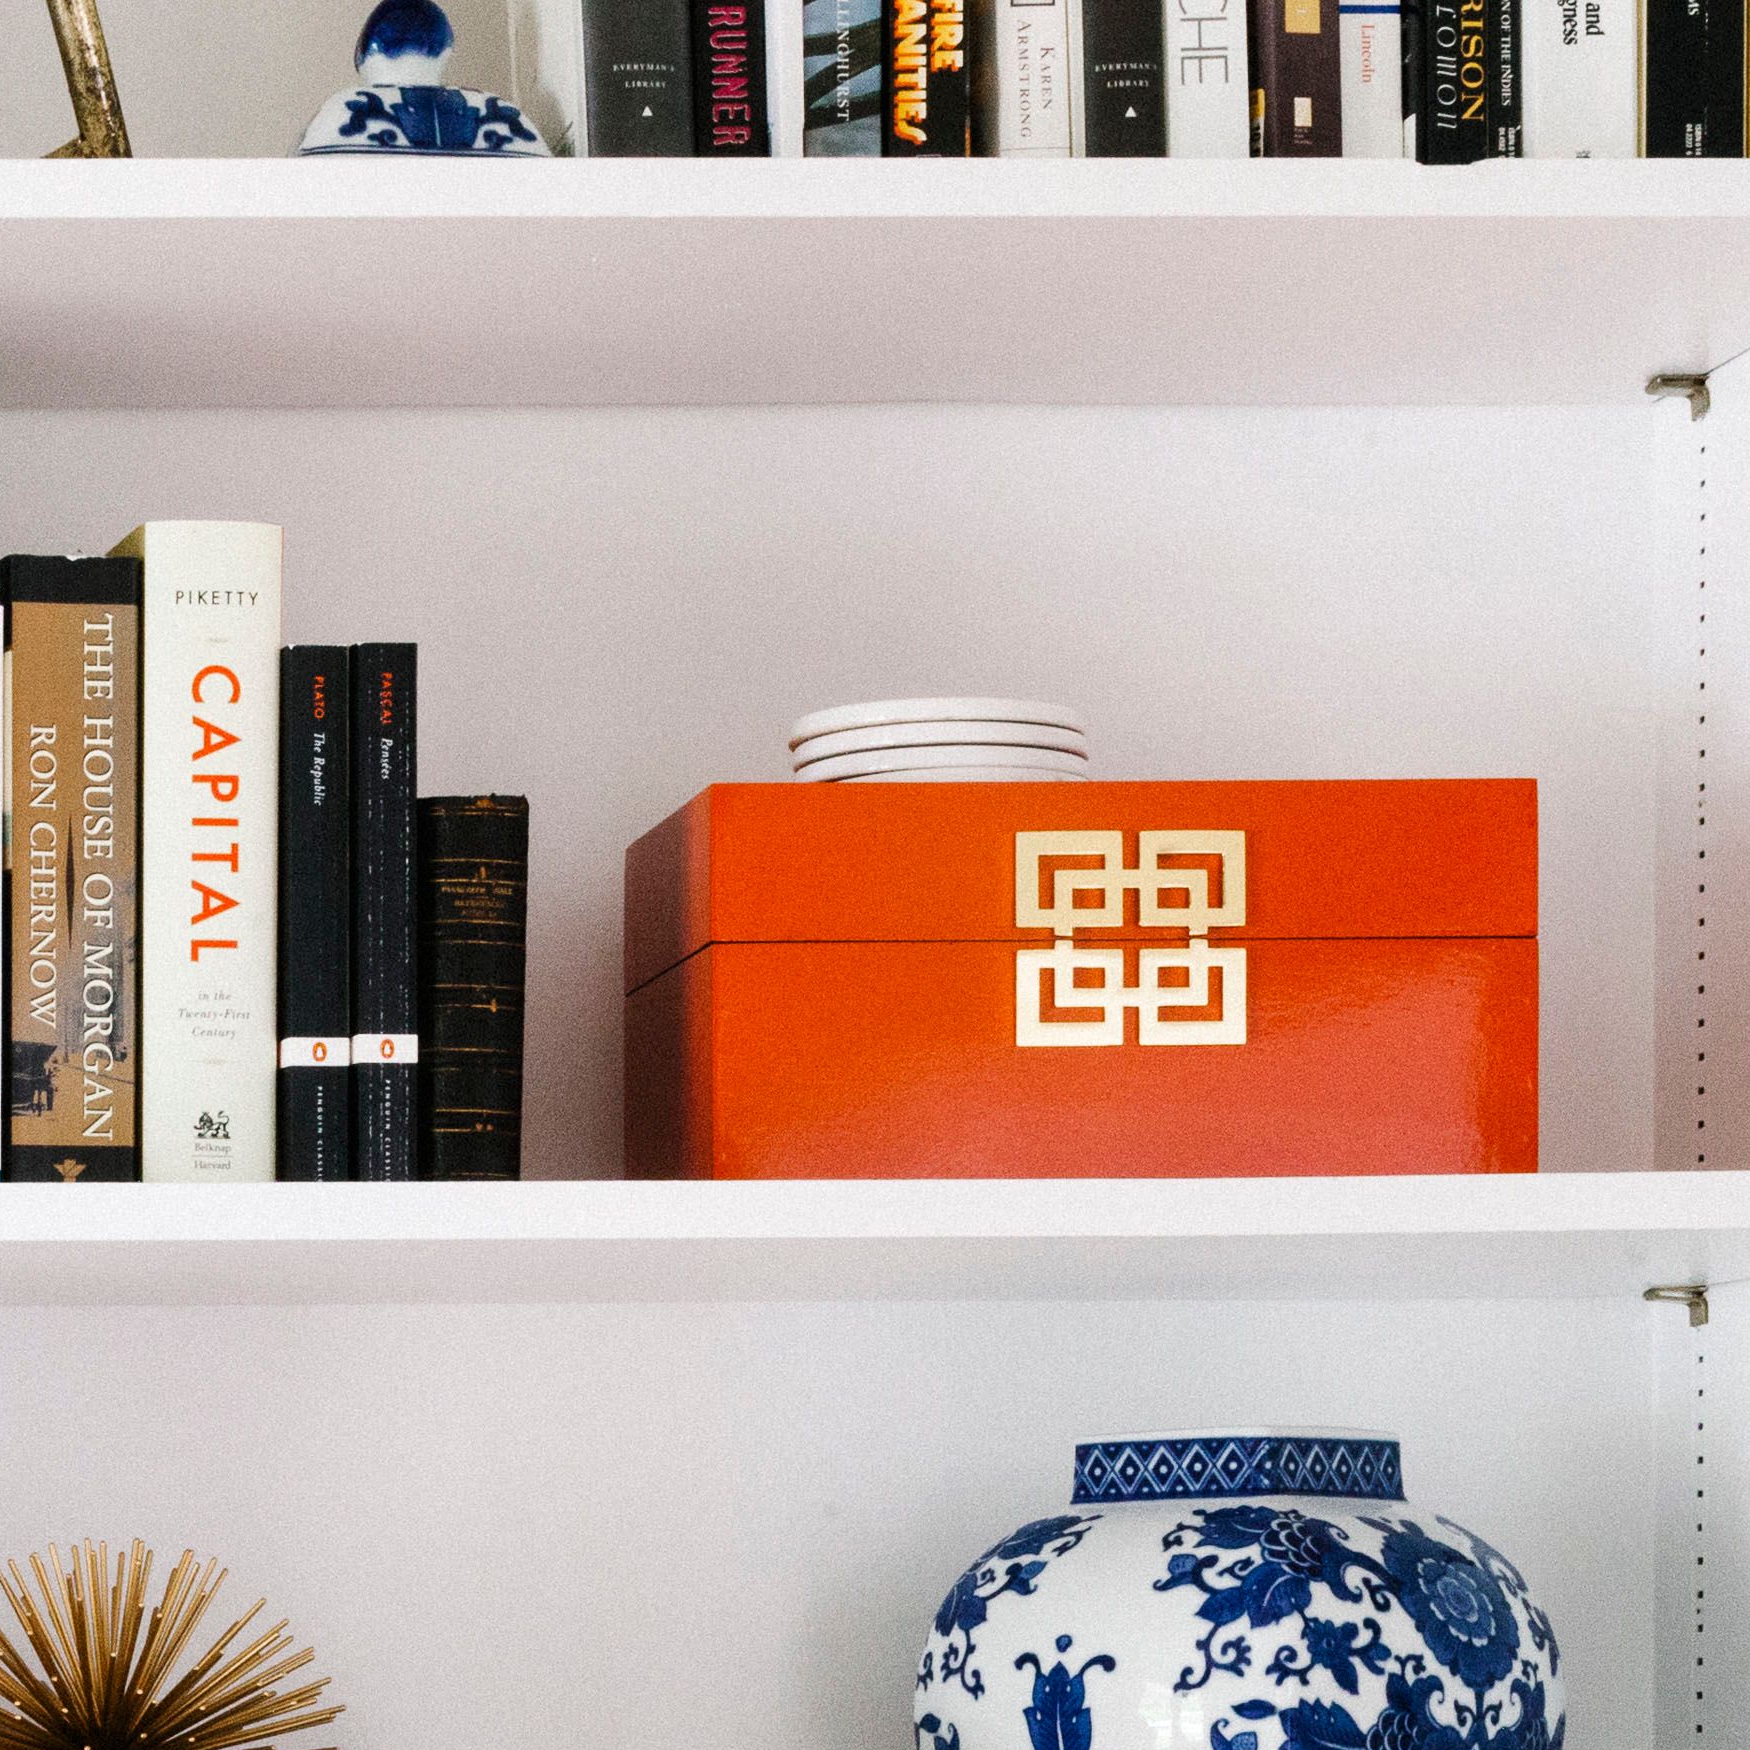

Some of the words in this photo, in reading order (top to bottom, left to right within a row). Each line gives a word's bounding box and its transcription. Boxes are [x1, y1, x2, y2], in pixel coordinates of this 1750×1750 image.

[1360, 24, 1375, 84] Lincoln
[1500, 14, 1511, 32] OF
[1500, 35, 1511, 61] THE
[1585, 2, 1605, 36] and
[707, 5, 750, 147] RUNNER
[1017, 19, 1032, 138] ARMSTRONG
[1040, 46, 1054, 110] KAREN
[1501, 64, 1512, 106] INDIES
[175, 591, 259, 606] PIKETTY
[83, 613, 113, 700] THE
[30, 724, 57, 810] RON
[83, 715, 113, 859] HOUSE
[191, 665, 241, 962] CAPITAL
[30, 822, 57, 1030] CHERNOW
[83, 872, 113, 928] OF
[83, 942, 114, 1140] MORGAN
